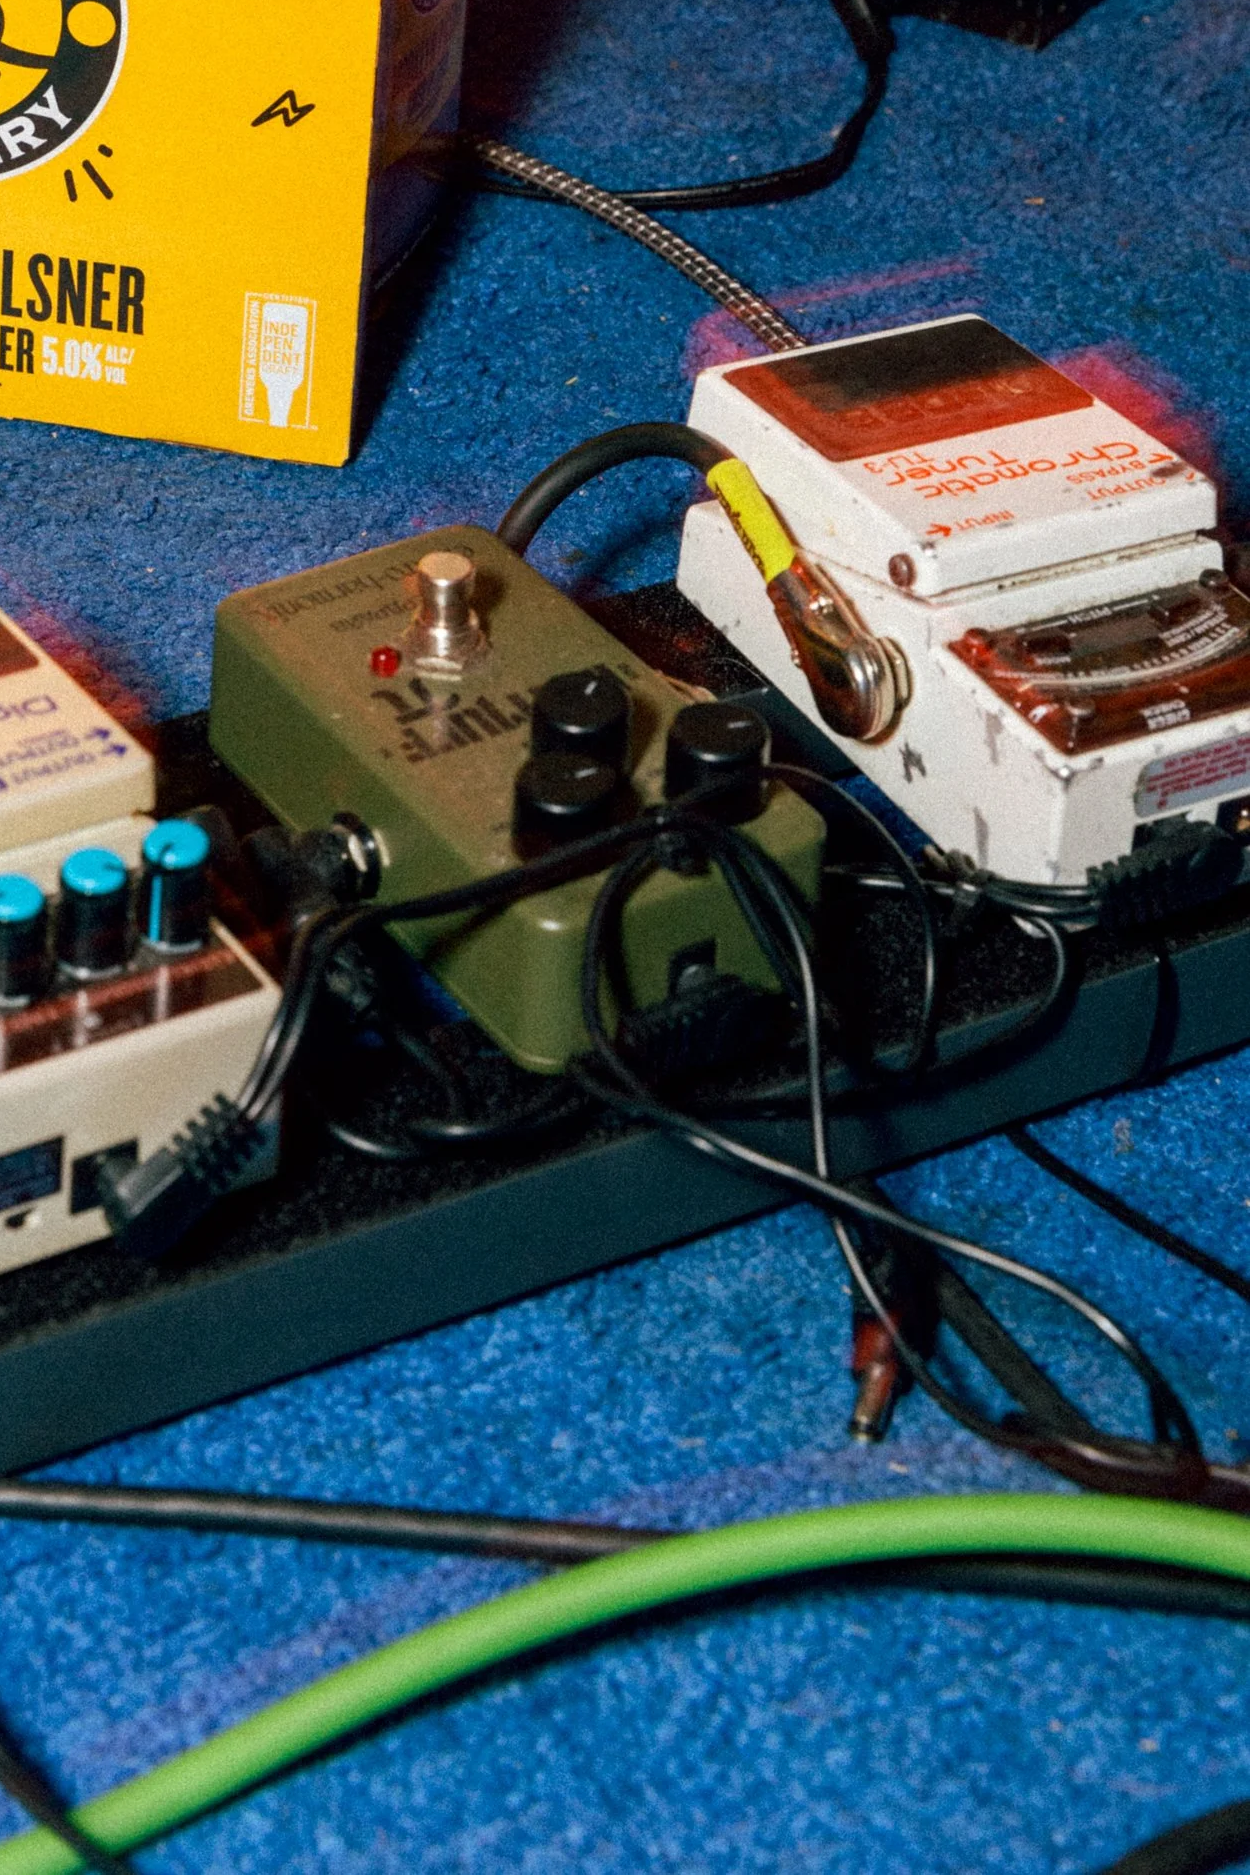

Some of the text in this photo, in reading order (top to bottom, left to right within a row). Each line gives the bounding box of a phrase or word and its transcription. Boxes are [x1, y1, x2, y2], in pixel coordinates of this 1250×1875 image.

[264, 320, 299, 338] INDE
[263, 334, 294, 351] PEN
[41, 335, 104, 382] 5.0%
[262, 348, 301, 366] DENT
[886, 449, 1018, 487] Tuner
[914, 441, 1139, 500] Chromatic
[1065, 460, 1147, 486] BYPASS
